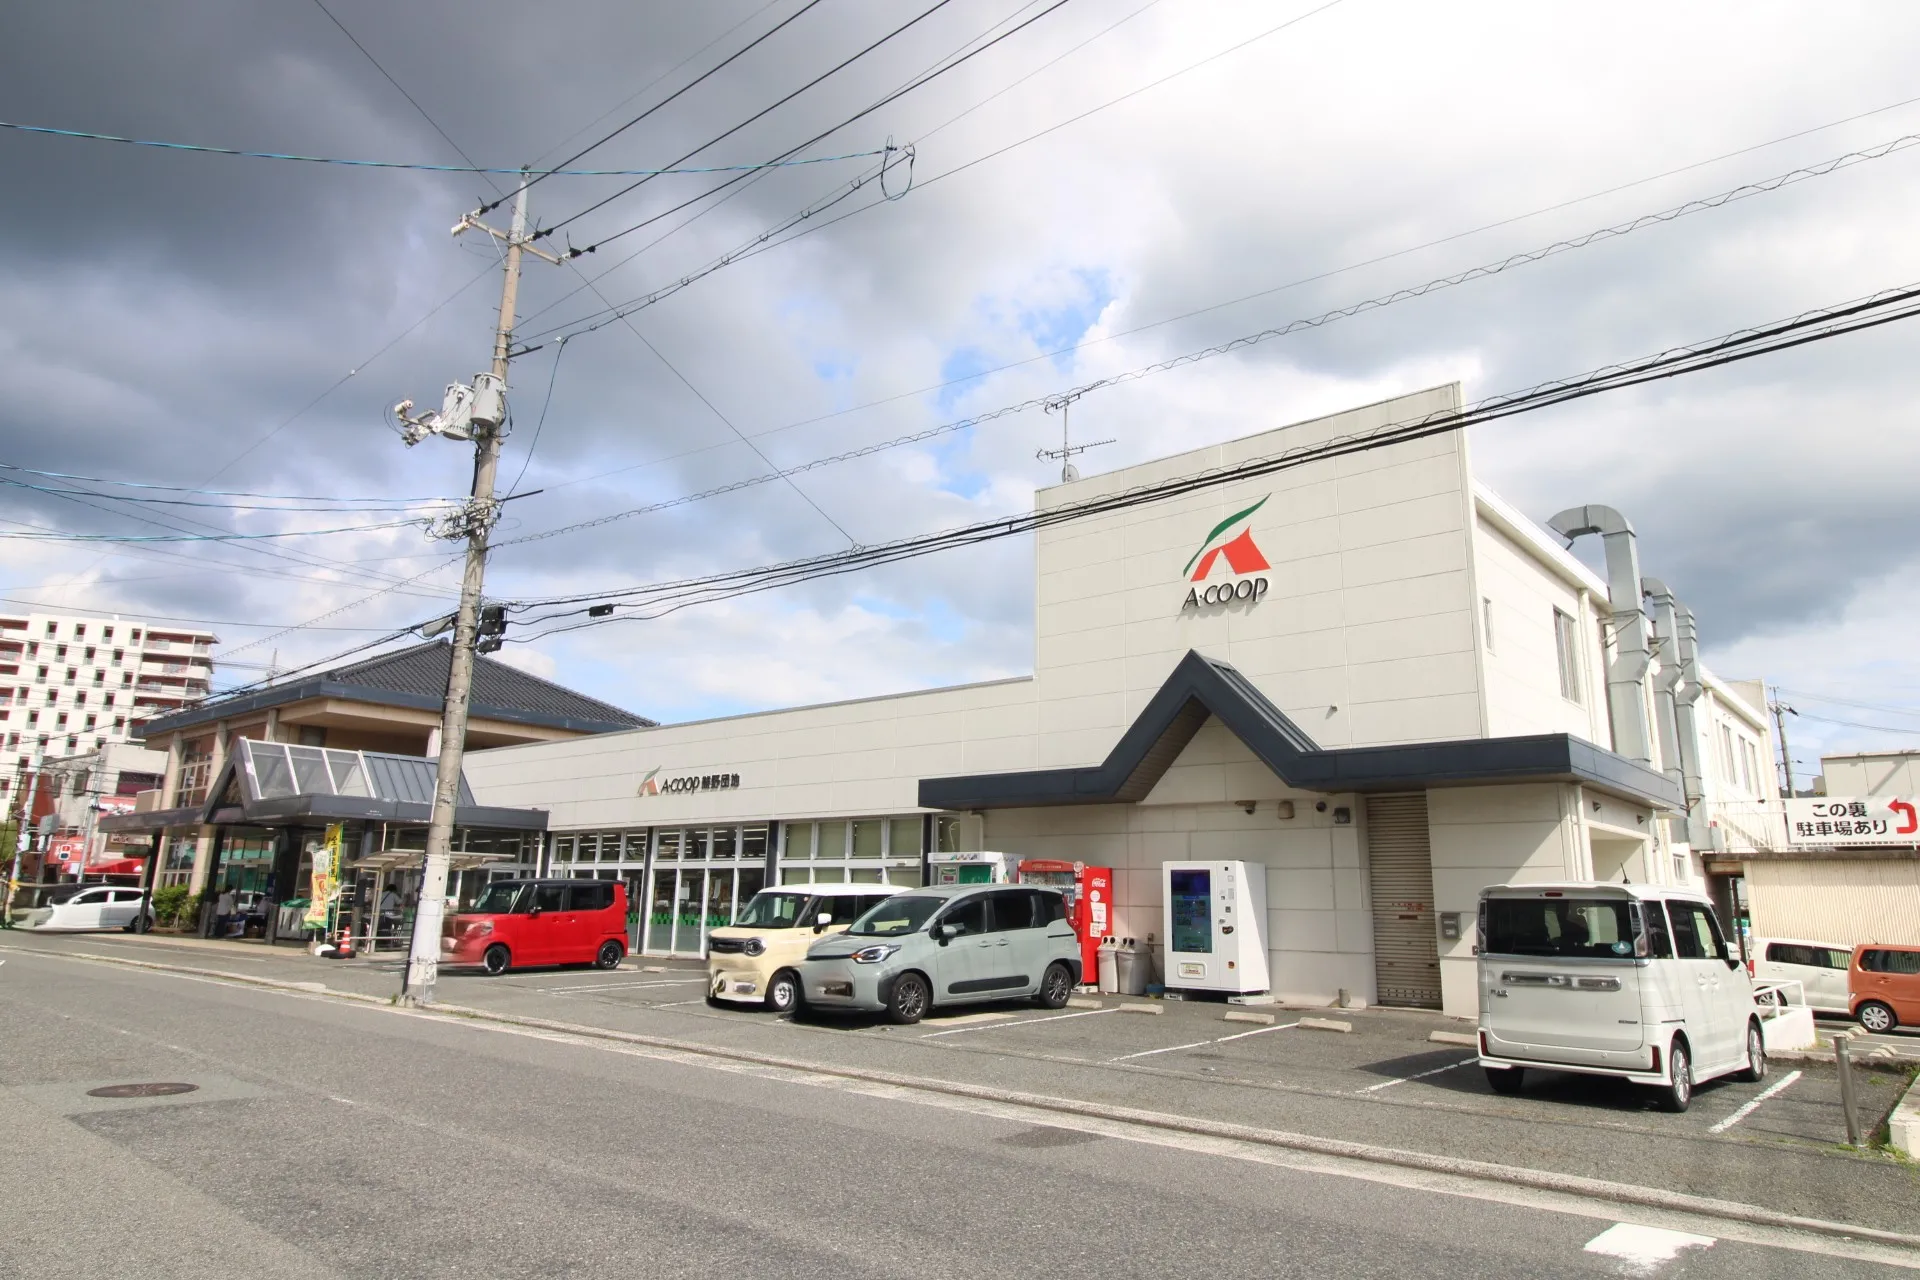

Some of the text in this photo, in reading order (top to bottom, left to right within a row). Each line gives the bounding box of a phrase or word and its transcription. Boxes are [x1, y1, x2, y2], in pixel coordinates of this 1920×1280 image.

[1812, 801, 1868, 818] この裏
[1796, 819, 1887, 837] 駐車場あり
